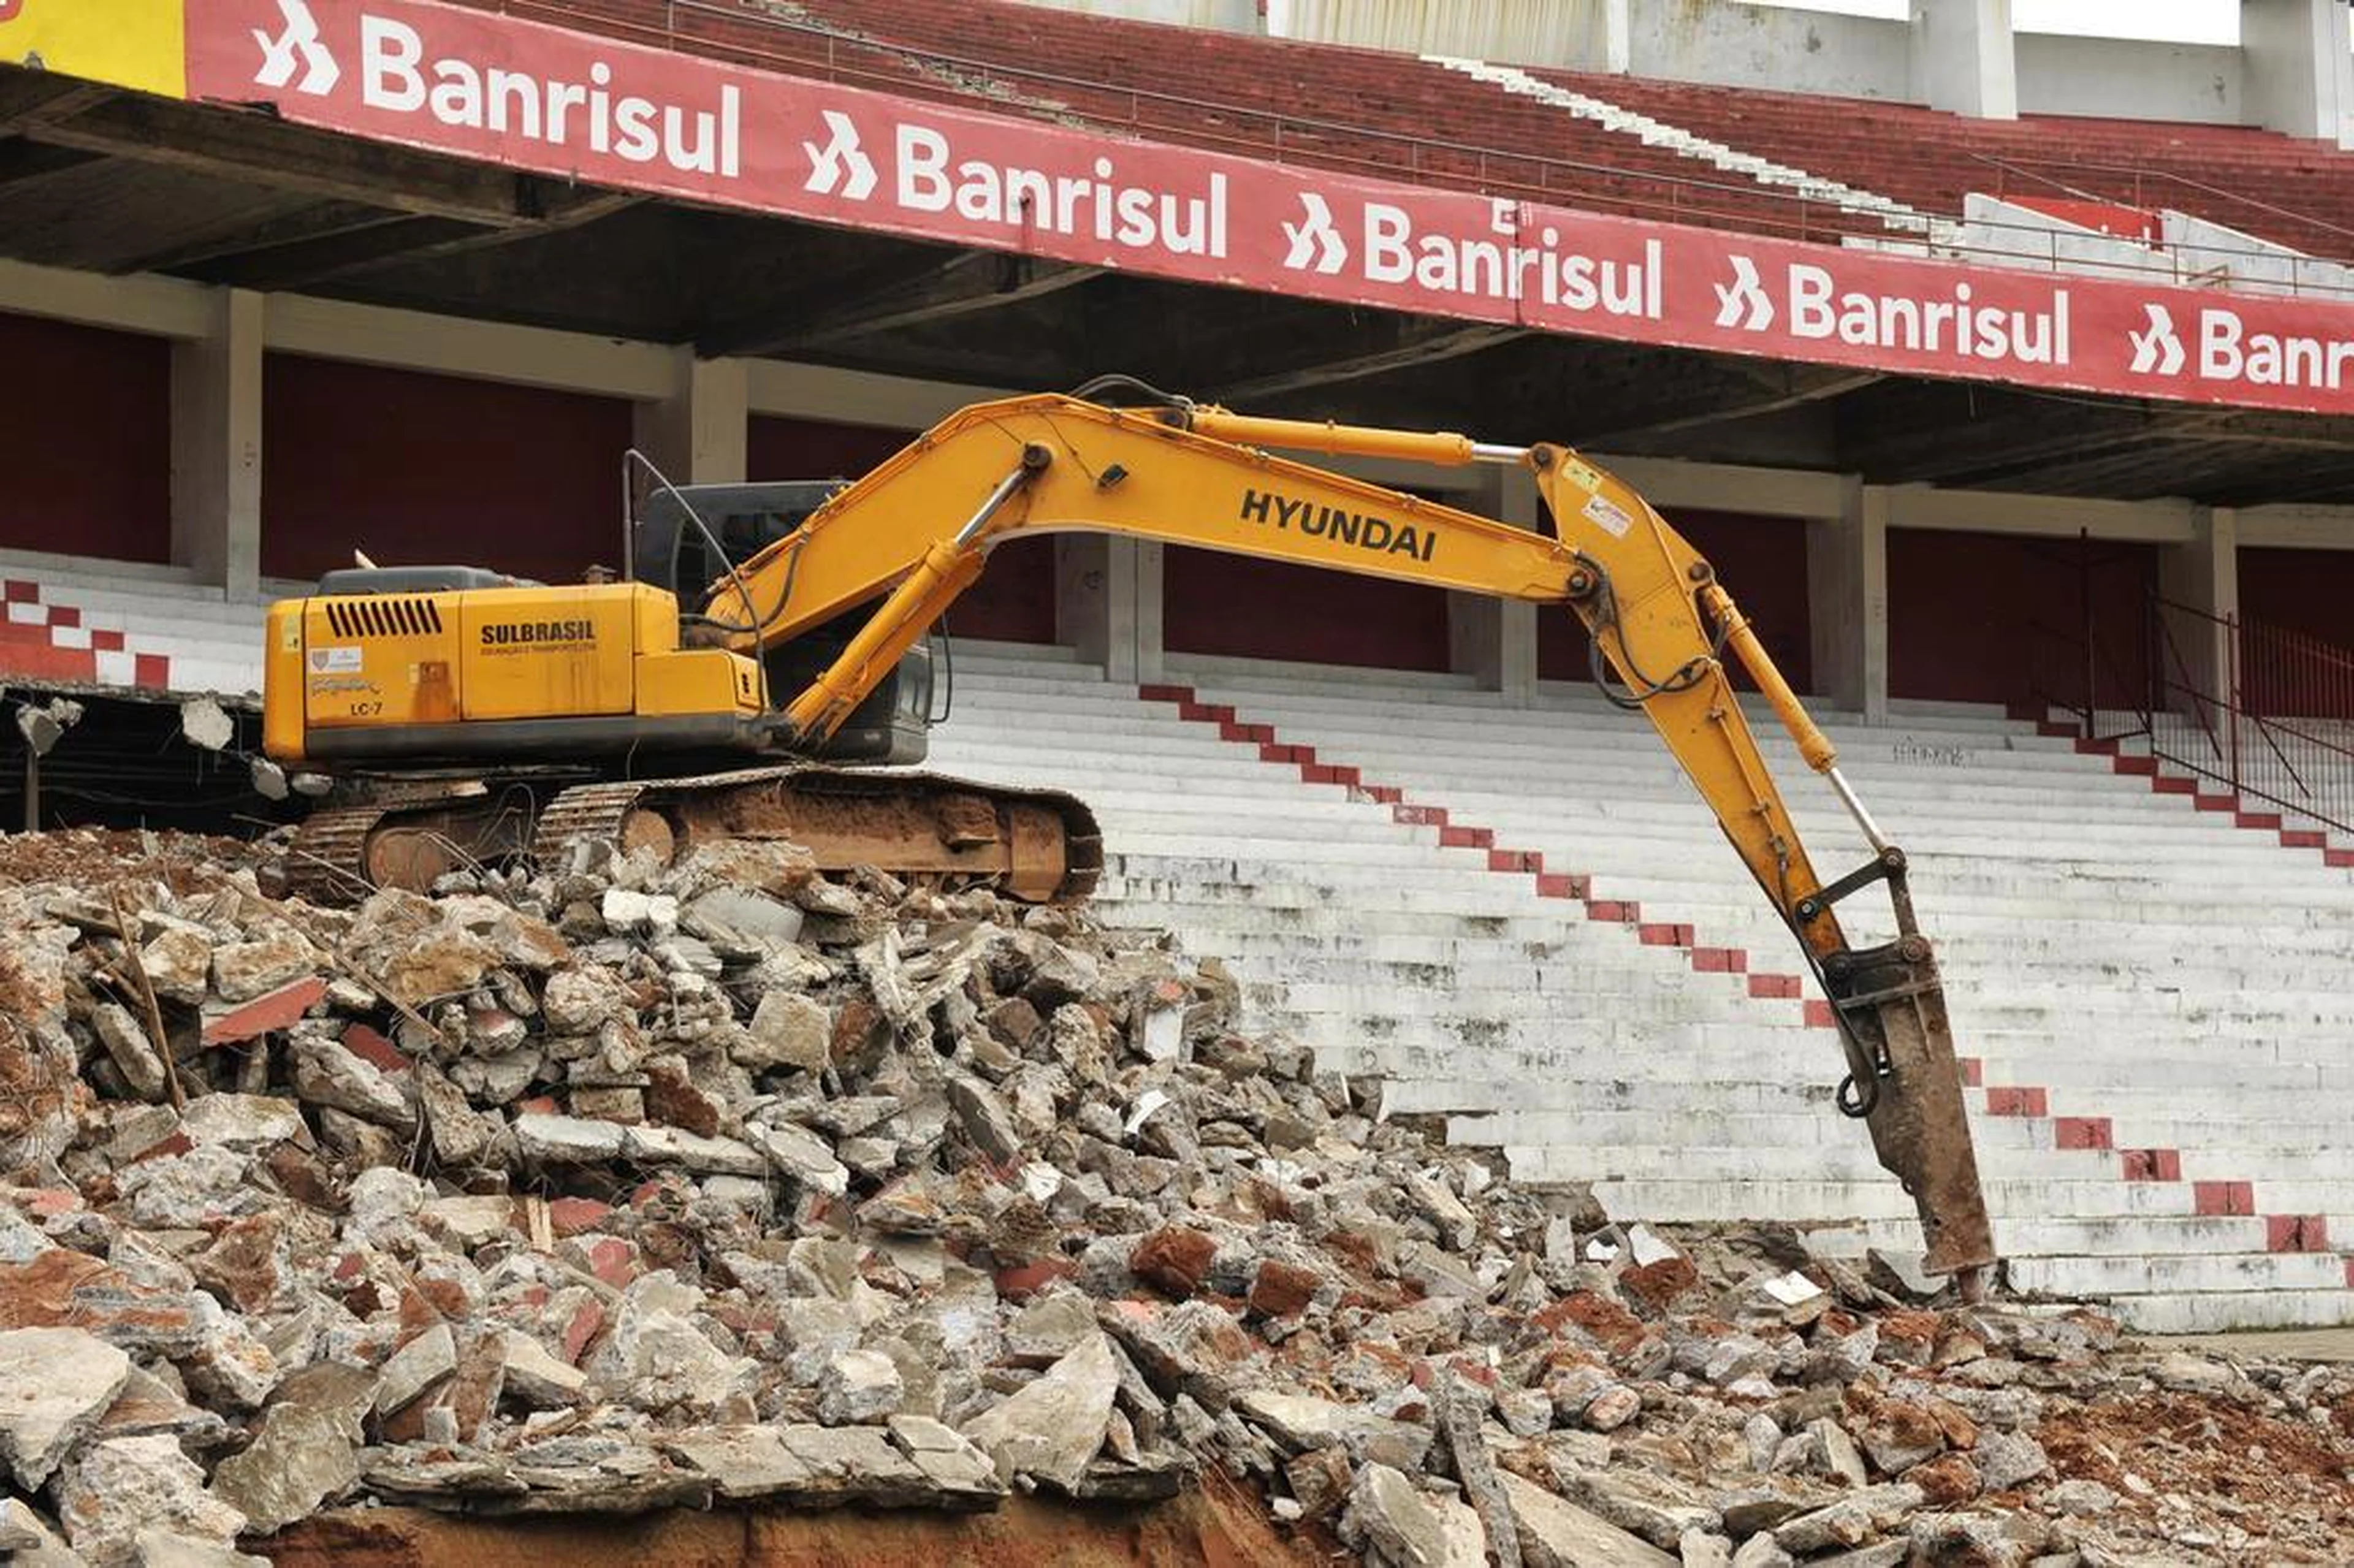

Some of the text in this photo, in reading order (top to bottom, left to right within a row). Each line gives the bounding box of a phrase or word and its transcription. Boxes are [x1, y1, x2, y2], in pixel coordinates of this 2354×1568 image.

[360, 13, 739, 177] Banrisul
[896, 123, 1227, 258] Banrisul
[1364, 202, 1661, 319] Banrisul
[1789, 263, 2069, 365] Banrisul
[2200, 309, 2354, 389] Banr
[1240, 489, 1436, 562] HYUNDAI
[481, 620, 596, 644] SULBRASIL
[350, 702, 383, 716] LC-7
